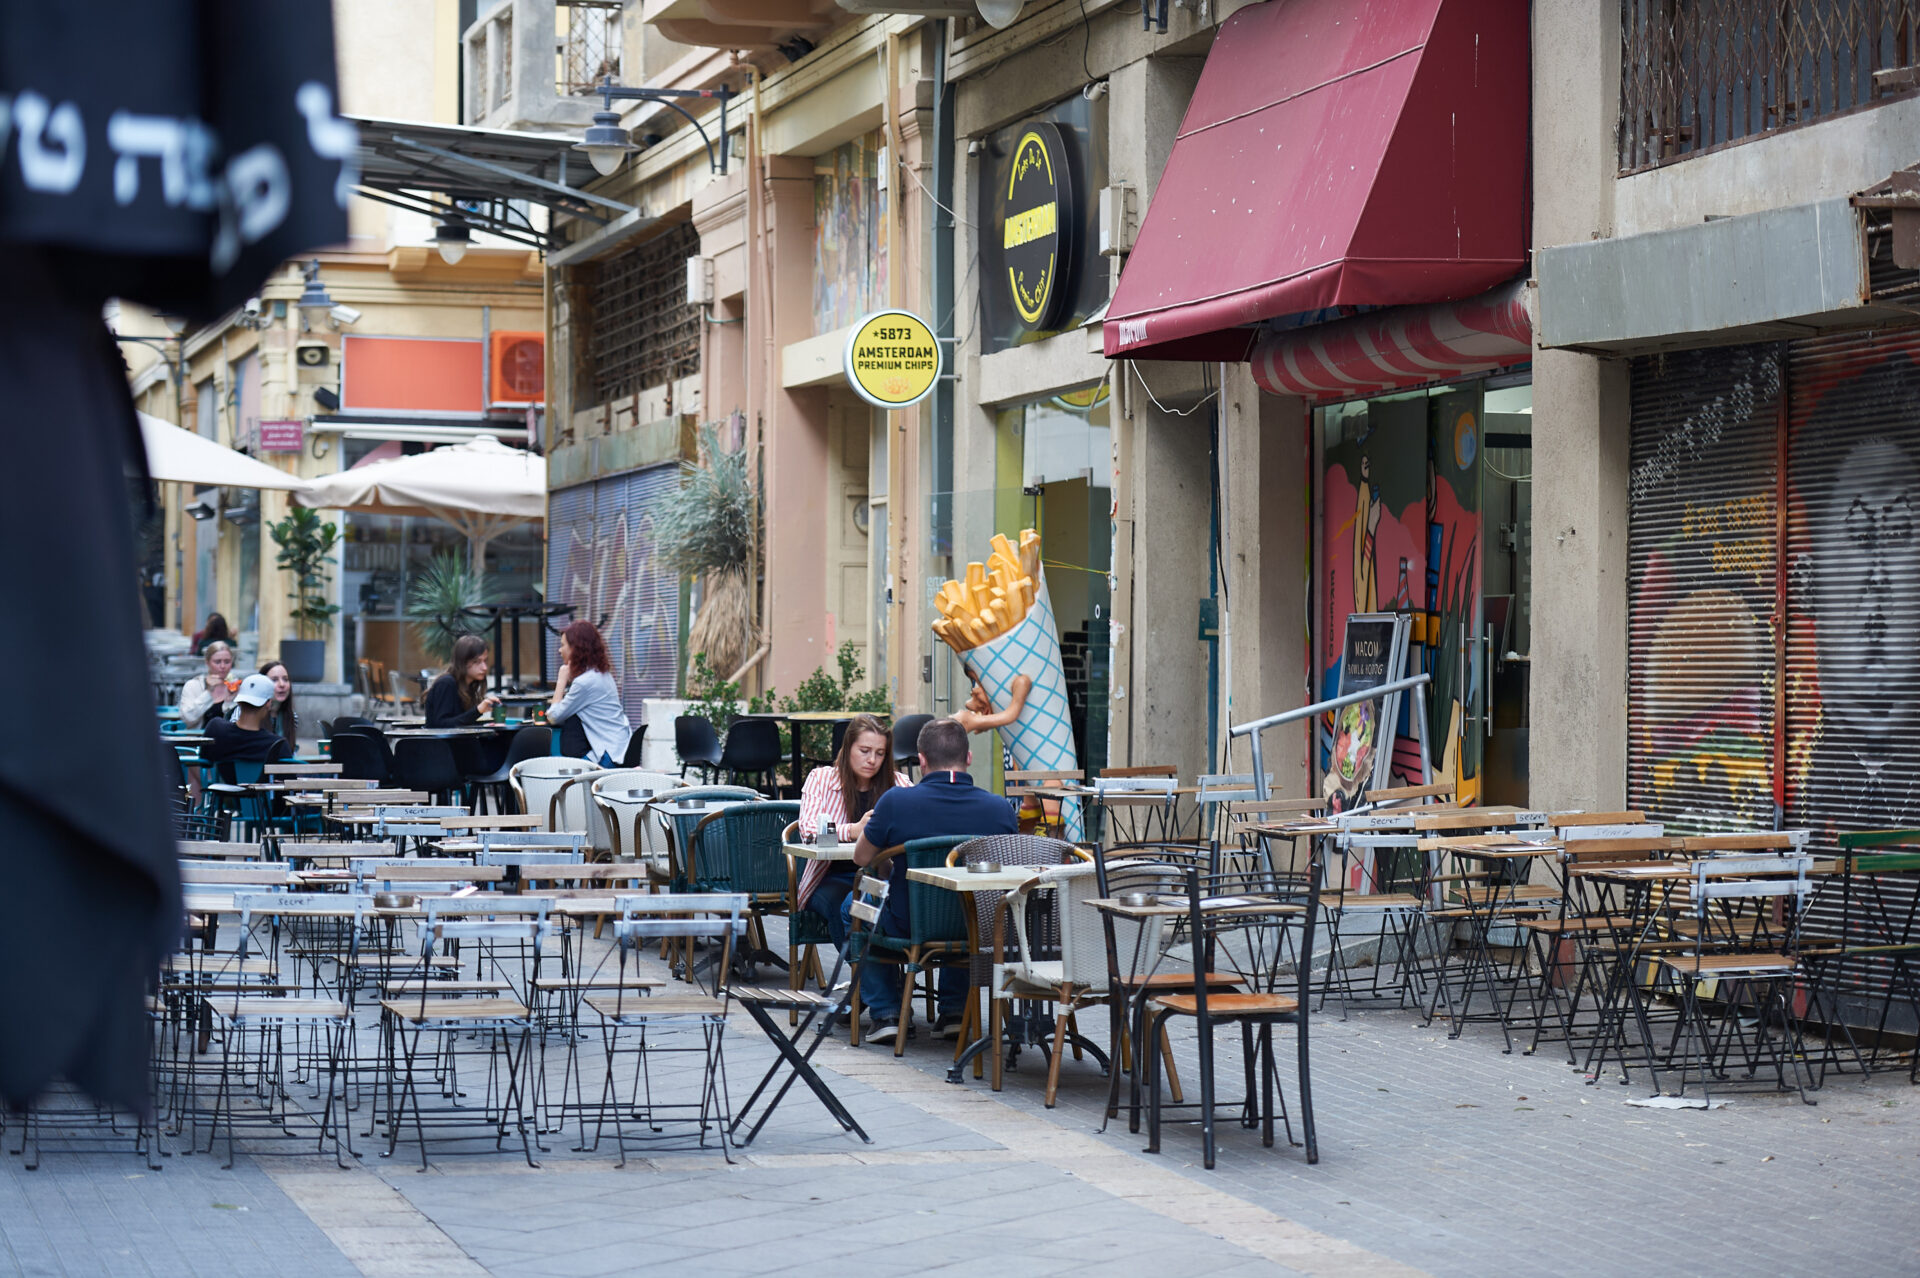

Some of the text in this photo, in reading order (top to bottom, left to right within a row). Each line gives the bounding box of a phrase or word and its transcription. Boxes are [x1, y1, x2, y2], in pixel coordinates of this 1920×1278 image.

[858, 346, 933, 358] AMSTERDAM
[858, 361, 933, 370] PREMIUM CHIPS
[1354, 641, 1379, 657] MACON
